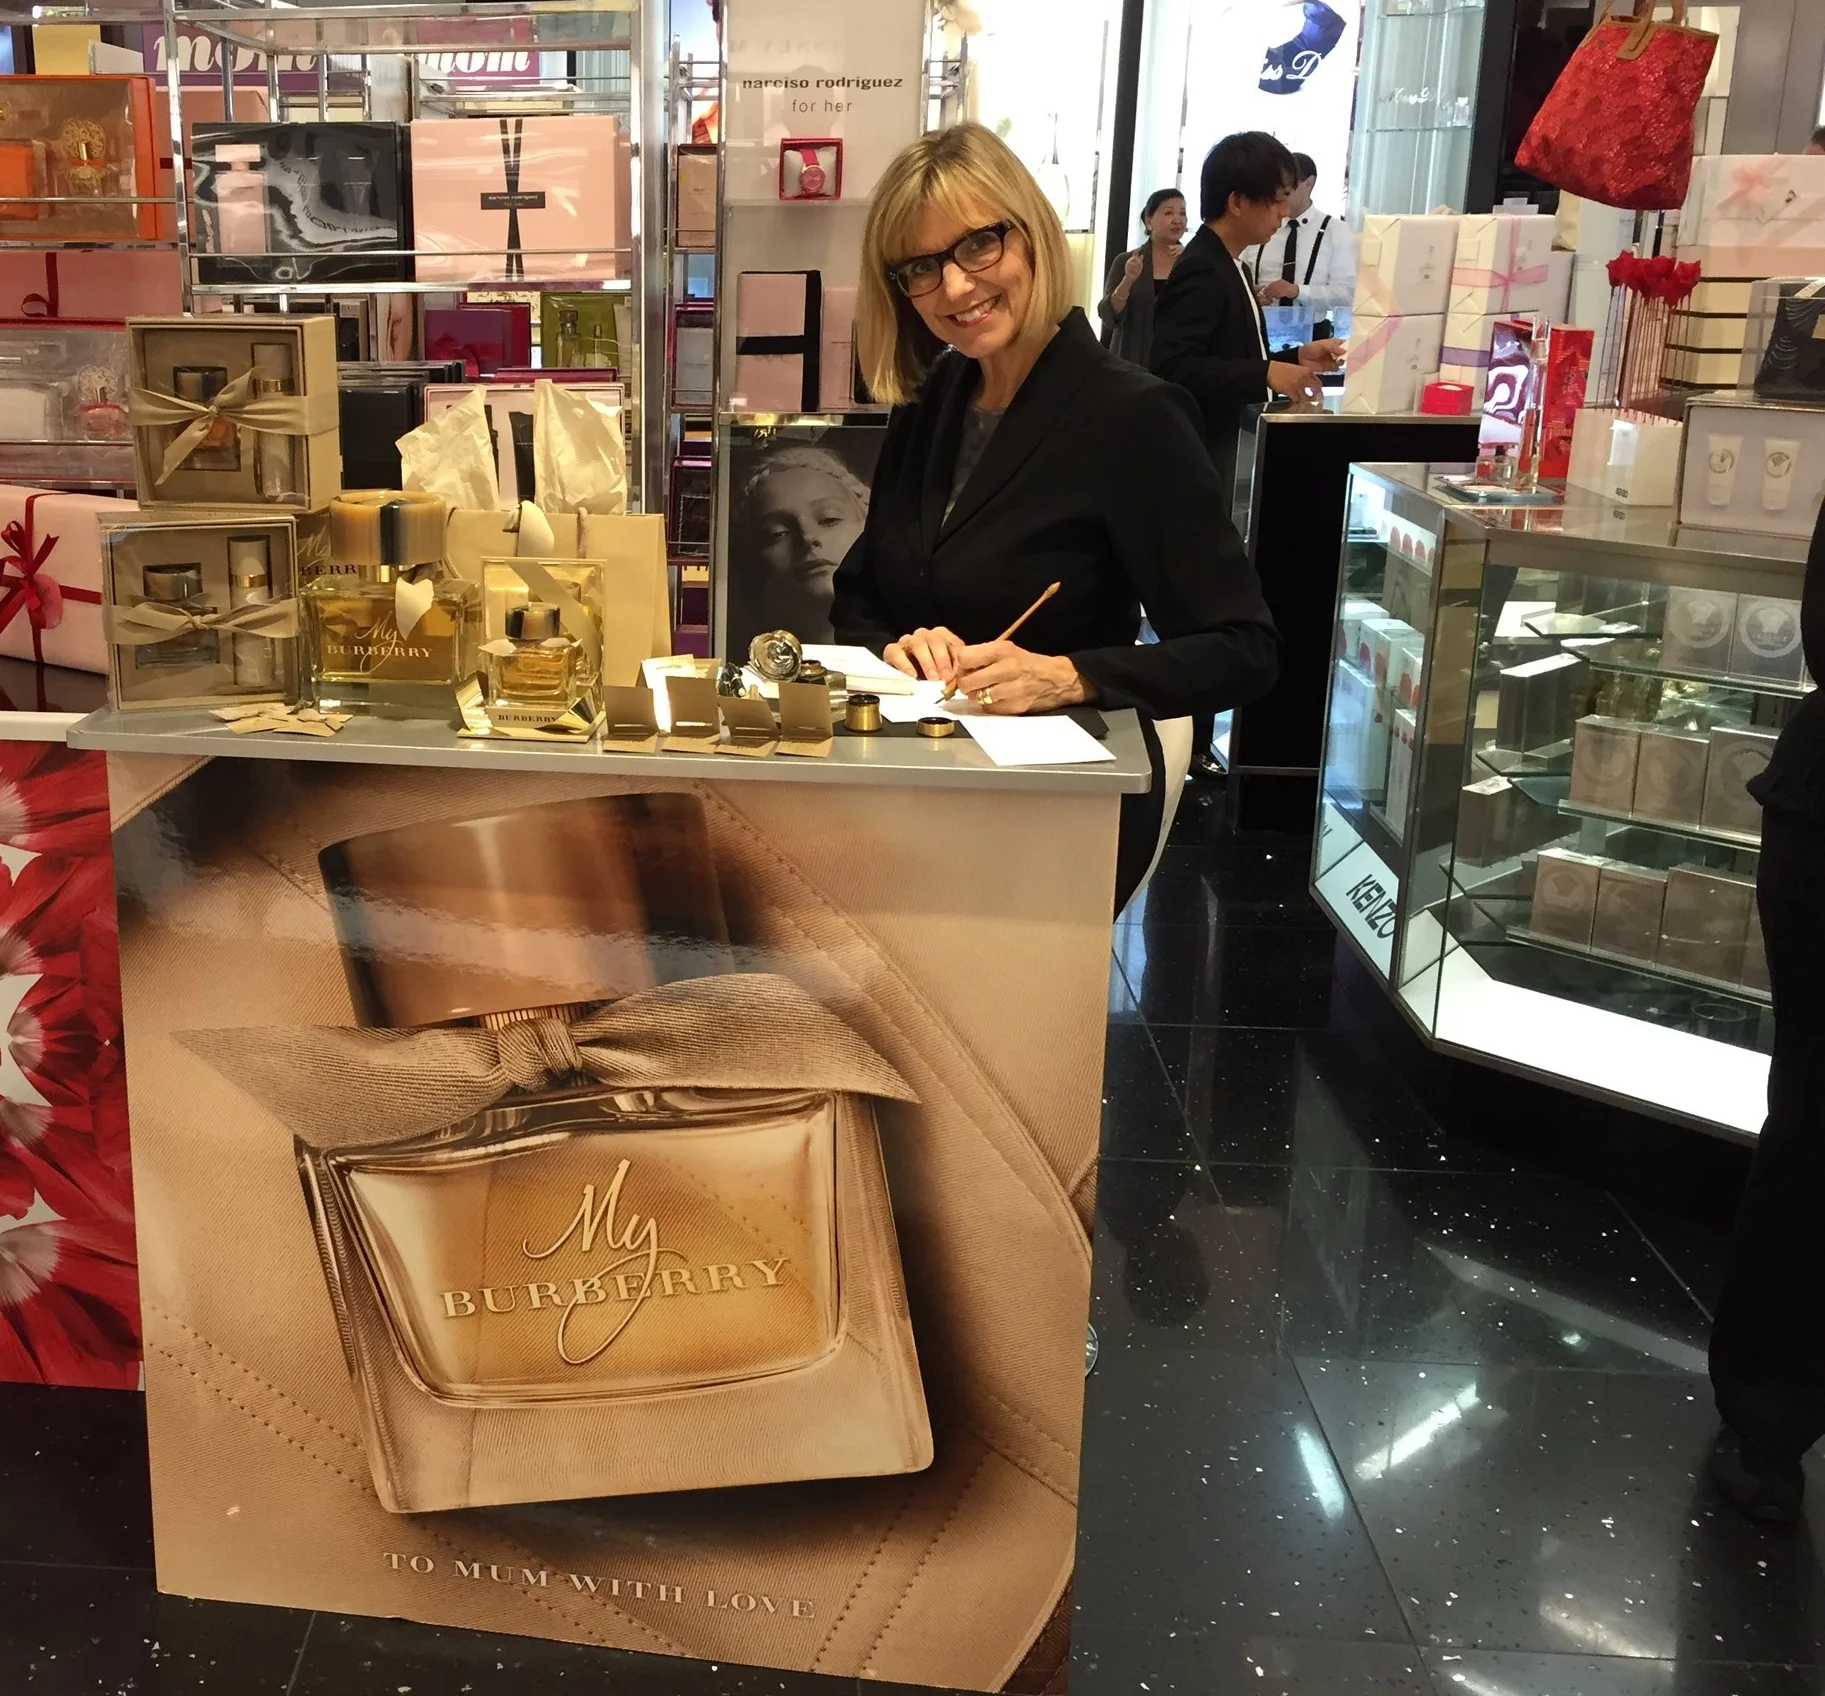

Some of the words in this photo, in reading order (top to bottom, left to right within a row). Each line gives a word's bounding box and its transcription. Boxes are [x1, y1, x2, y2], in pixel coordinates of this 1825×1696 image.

[743, 76, 809, 89] narciso
[816, 76, 903, 90] rodriguez
[792, 99, 816, 112] for
[824, 99, 853, 112] her
[326, 645, 432, 658] BURBERRY
[355, 611, 404, 673] My
[498, 714, 557, 722] BURBERRY
[1346, 873, 1397, 939] KENZO
[438, 1257, 791, 1318] BURBERRY
[523, 1159, 688, 1365] My
[383, 1551, 435, 1574] TO
[453, 1559, 549, 1588] MUM
[567, 1573, 685, 1604] WITH
[706, 1589, 815, 1619] LOVE
